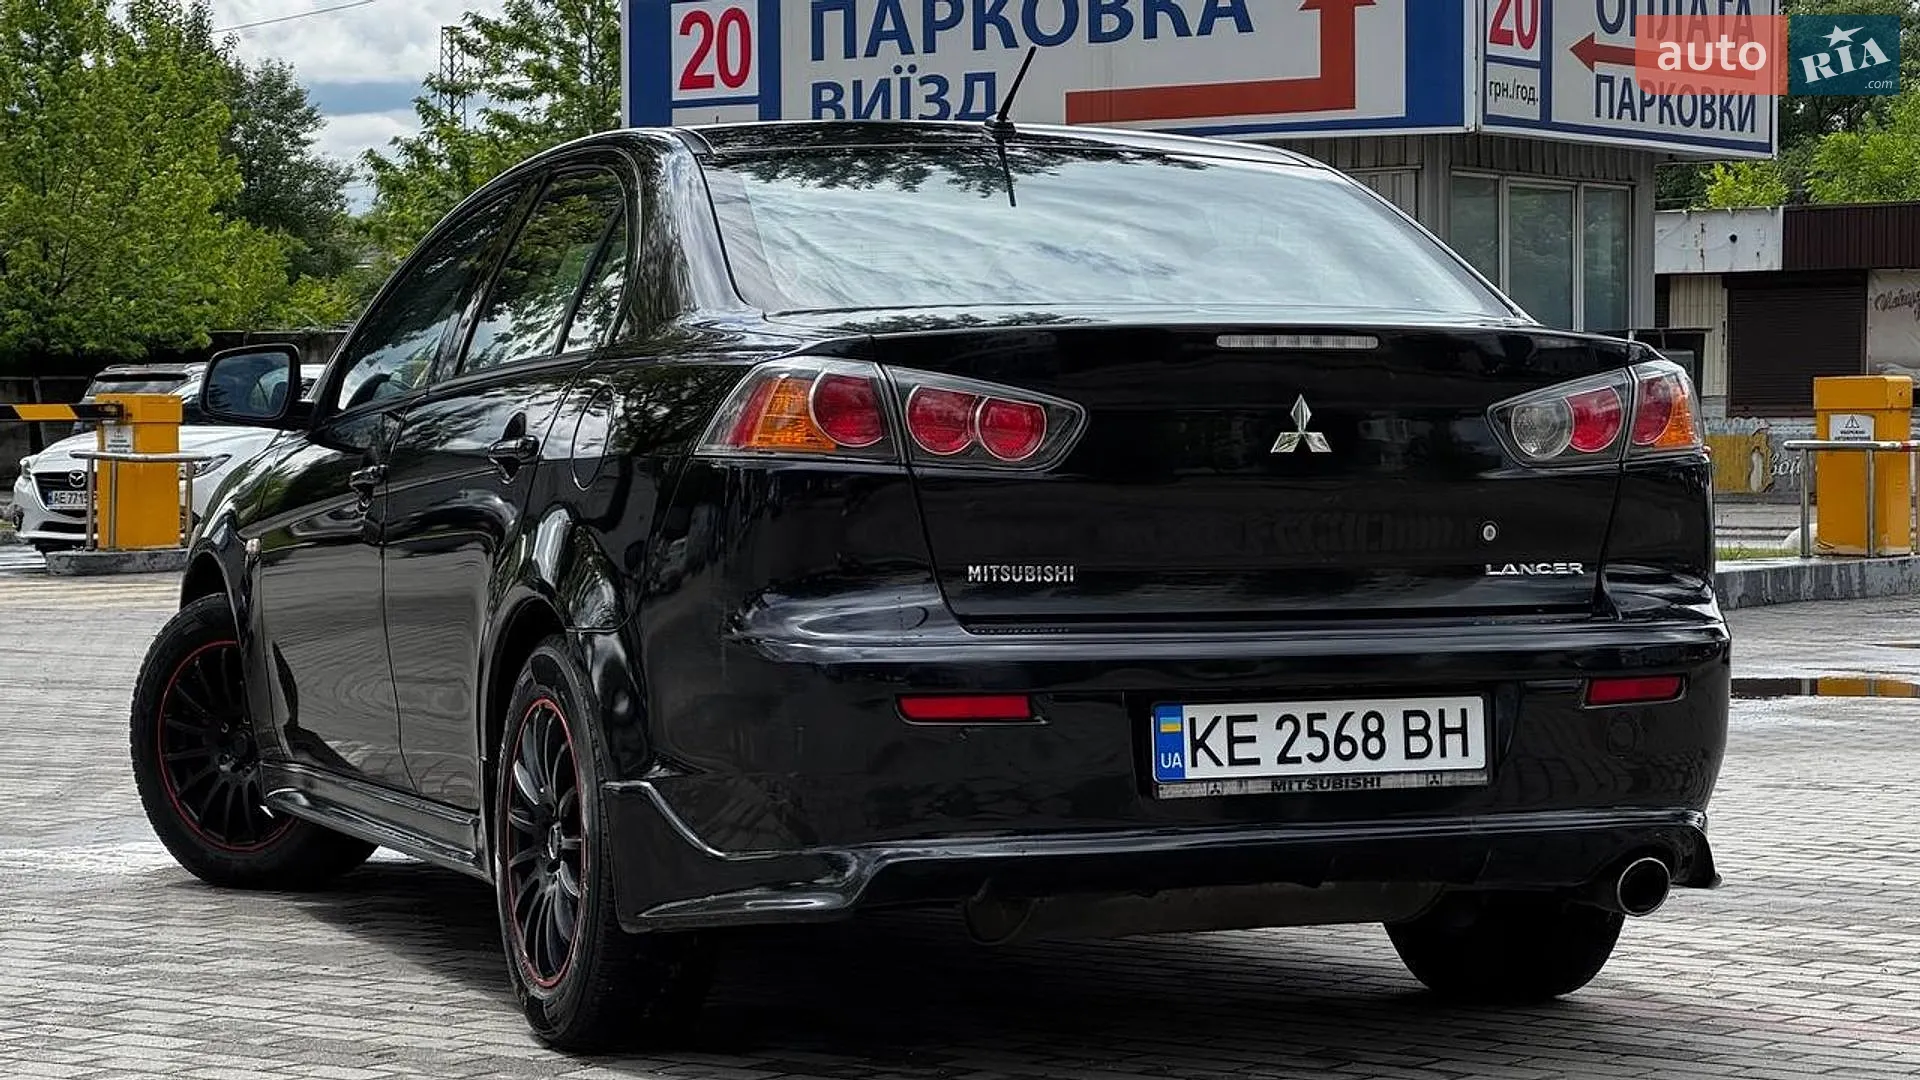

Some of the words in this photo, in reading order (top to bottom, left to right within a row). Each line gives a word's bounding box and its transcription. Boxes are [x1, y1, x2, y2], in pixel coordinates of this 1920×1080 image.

[679, 7, 751, 91] 20
[811, 0, 1254, 61] ПАРКОВКА
[1488, 0, 1539, 50] 20
[811, 64, 997, 121] ВИЇЗД
[1595, 74, 1756, 133] ПАРКОВКИ
[967, 565, 1075, 583] MITSUBISHI
[1485, 562, 1584, 576] LANCER
[1161, 752, 1183, 769] UA
[1189, 714, 1261, 768] KE
[1275, 710, 1386, 765] 2568
[1403, 707, 1469, 760] BH
[1271, 776, 1382, 792] MITSUBISHI
